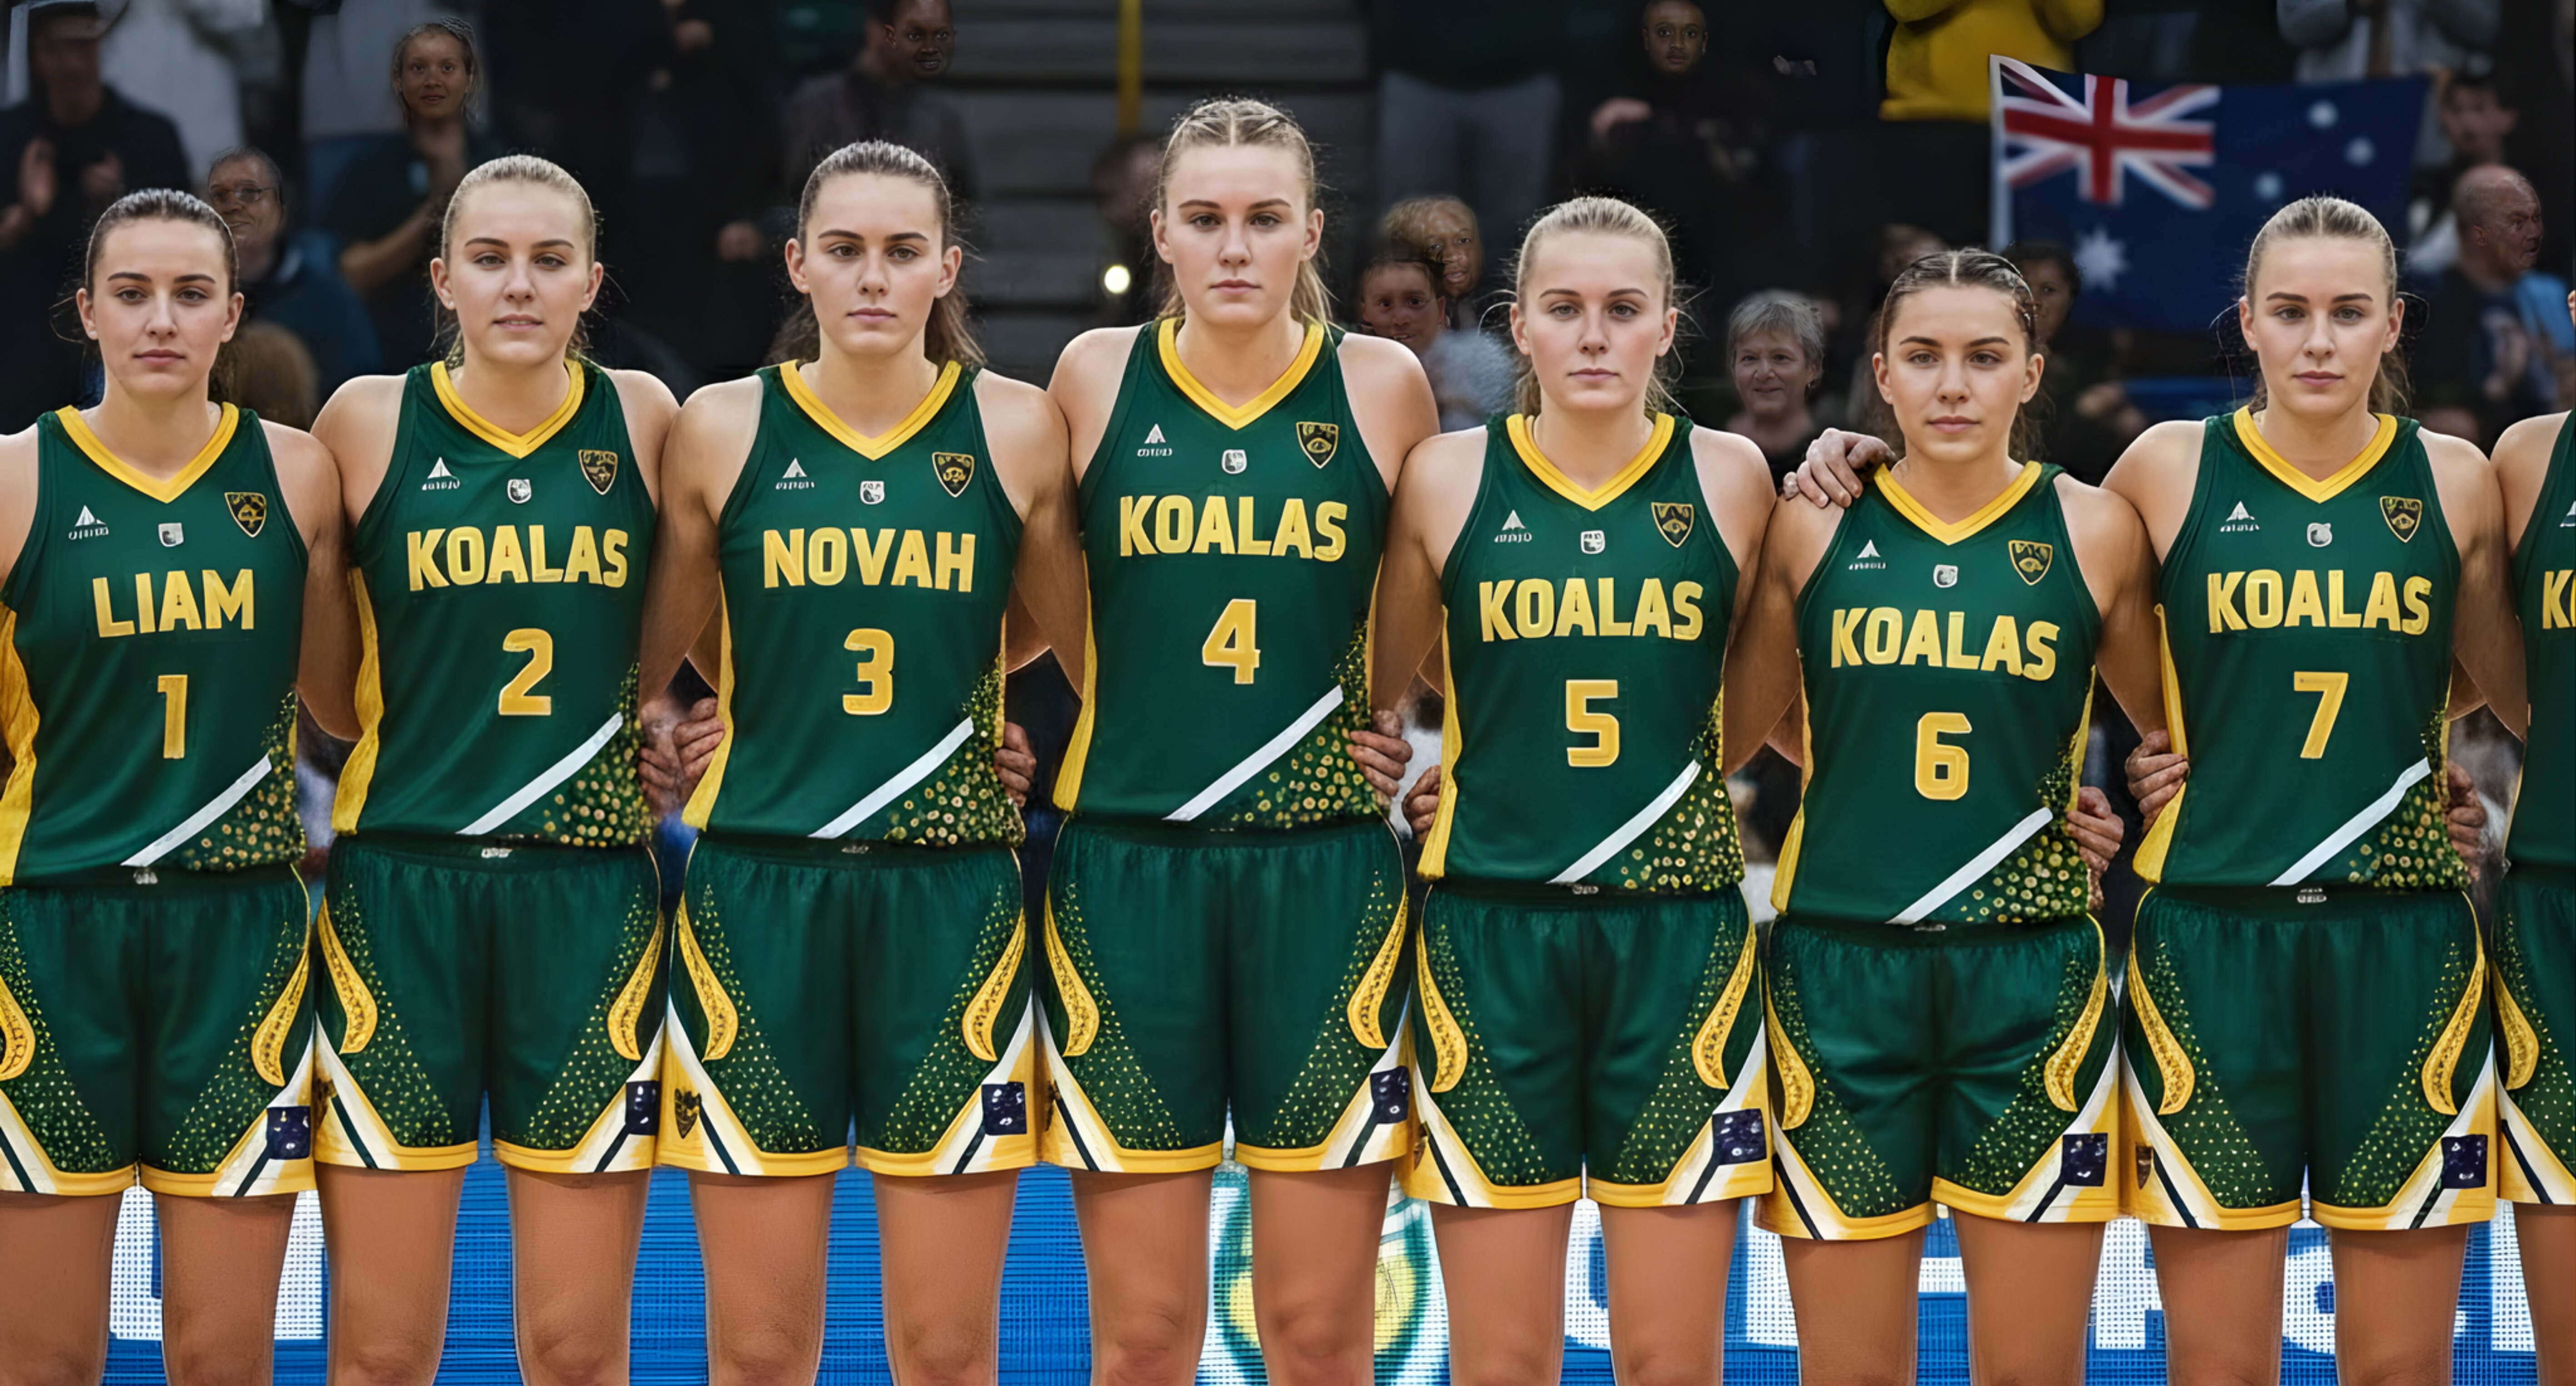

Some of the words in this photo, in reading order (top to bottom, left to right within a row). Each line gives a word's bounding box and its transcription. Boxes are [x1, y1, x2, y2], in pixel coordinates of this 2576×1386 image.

[406, 525, 629, 591] KOALAS
[763, 527, 976, 593] NOVAH
[1120, 495, 1348, 561] KOALAS
[93, 570, 256, 638] LIAM
[1478, 577, 1703, 642] KOALAS
[2207, 569, 2432, 635] KOALAS
[2542, 570, 2576, 629] K
[498, 628, 553, 716] 2
[842, 628, 895, 716] 3
[1200, 598, 1261, 684] 4
[1831, 607, 2060, 681] KOALAS
[158, 674, 188, 759] 1
[1565, 679, 1620, 768] 5
[2294, 671, 2349, 759] 7
[1915, 712, 1972, 801] 6
